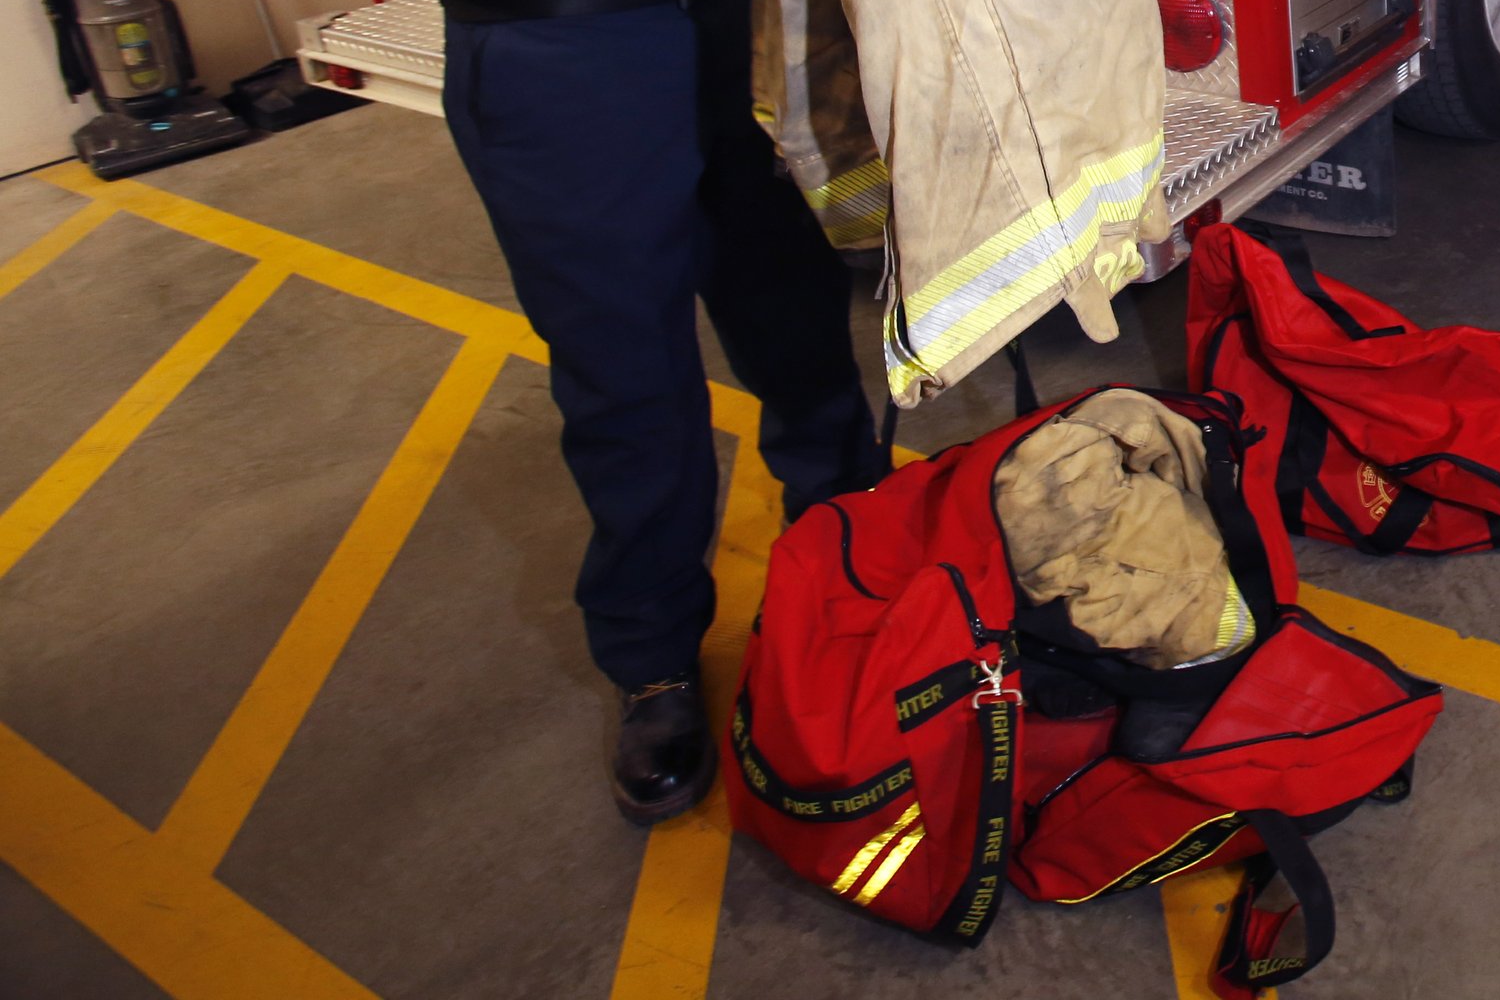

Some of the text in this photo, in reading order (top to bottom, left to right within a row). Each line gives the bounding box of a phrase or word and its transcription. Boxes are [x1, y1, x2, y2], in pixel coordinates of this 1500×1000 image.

[991, 700, 1010, 782] FIGHTER
[783, 766, 913, 815] FIRE FIGHTER
[982, 816, 1004, 865] FIRE
